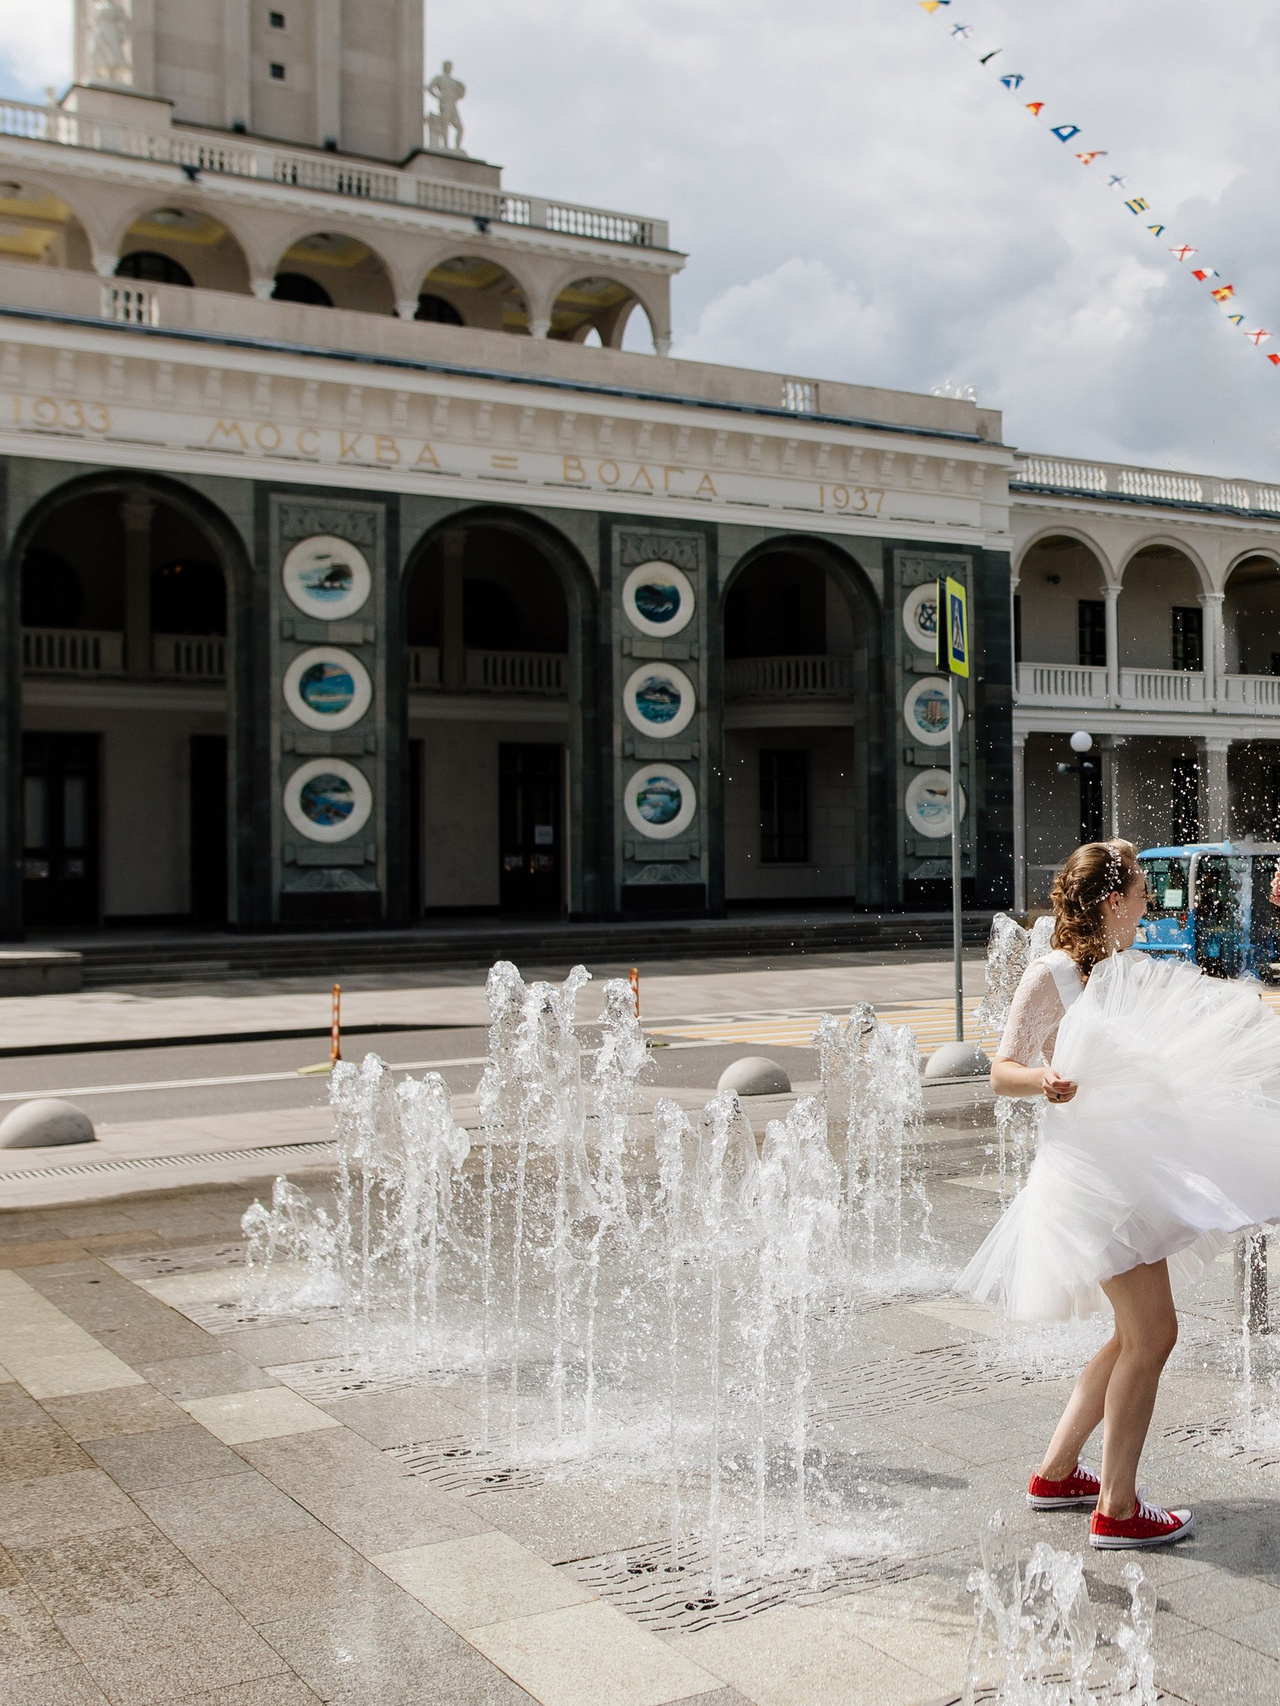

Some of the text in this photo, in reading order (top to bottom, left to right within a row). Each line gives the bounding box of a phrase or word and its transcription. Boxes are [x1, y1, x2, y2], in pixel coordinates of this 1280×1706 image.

[12, 394, 111, 432] 1933
[207, 419, 441, 468] МОСКВА
[563, 456, 717, 495] ВОЛГА
[818, 485, 886, 513] 1937
